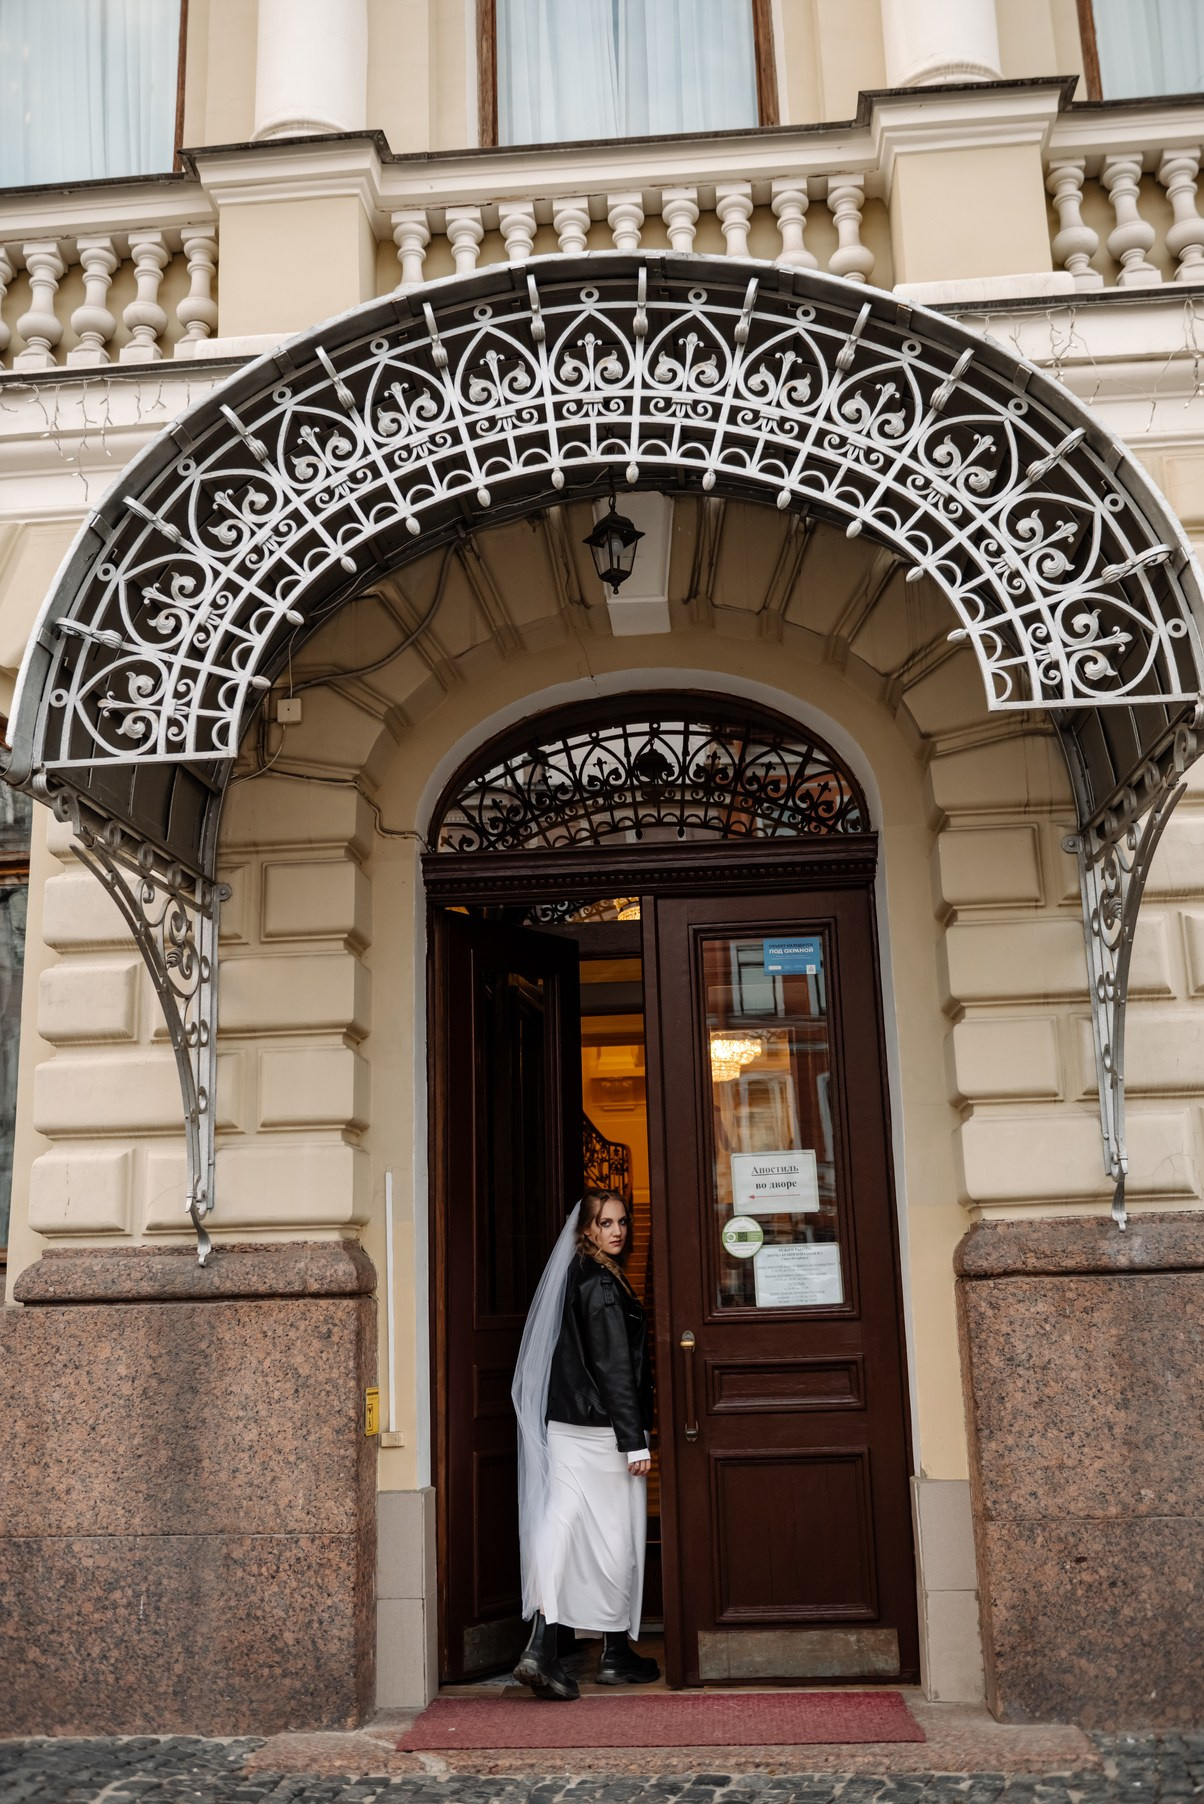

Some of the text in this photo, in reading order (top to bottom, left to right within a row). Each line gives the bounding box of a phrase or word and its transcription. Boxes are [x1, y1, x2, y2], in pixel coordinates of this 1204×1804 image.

[751, 1165, 799, 1175] Апостиль
[755, 1180, 797, 1190] во дворе
